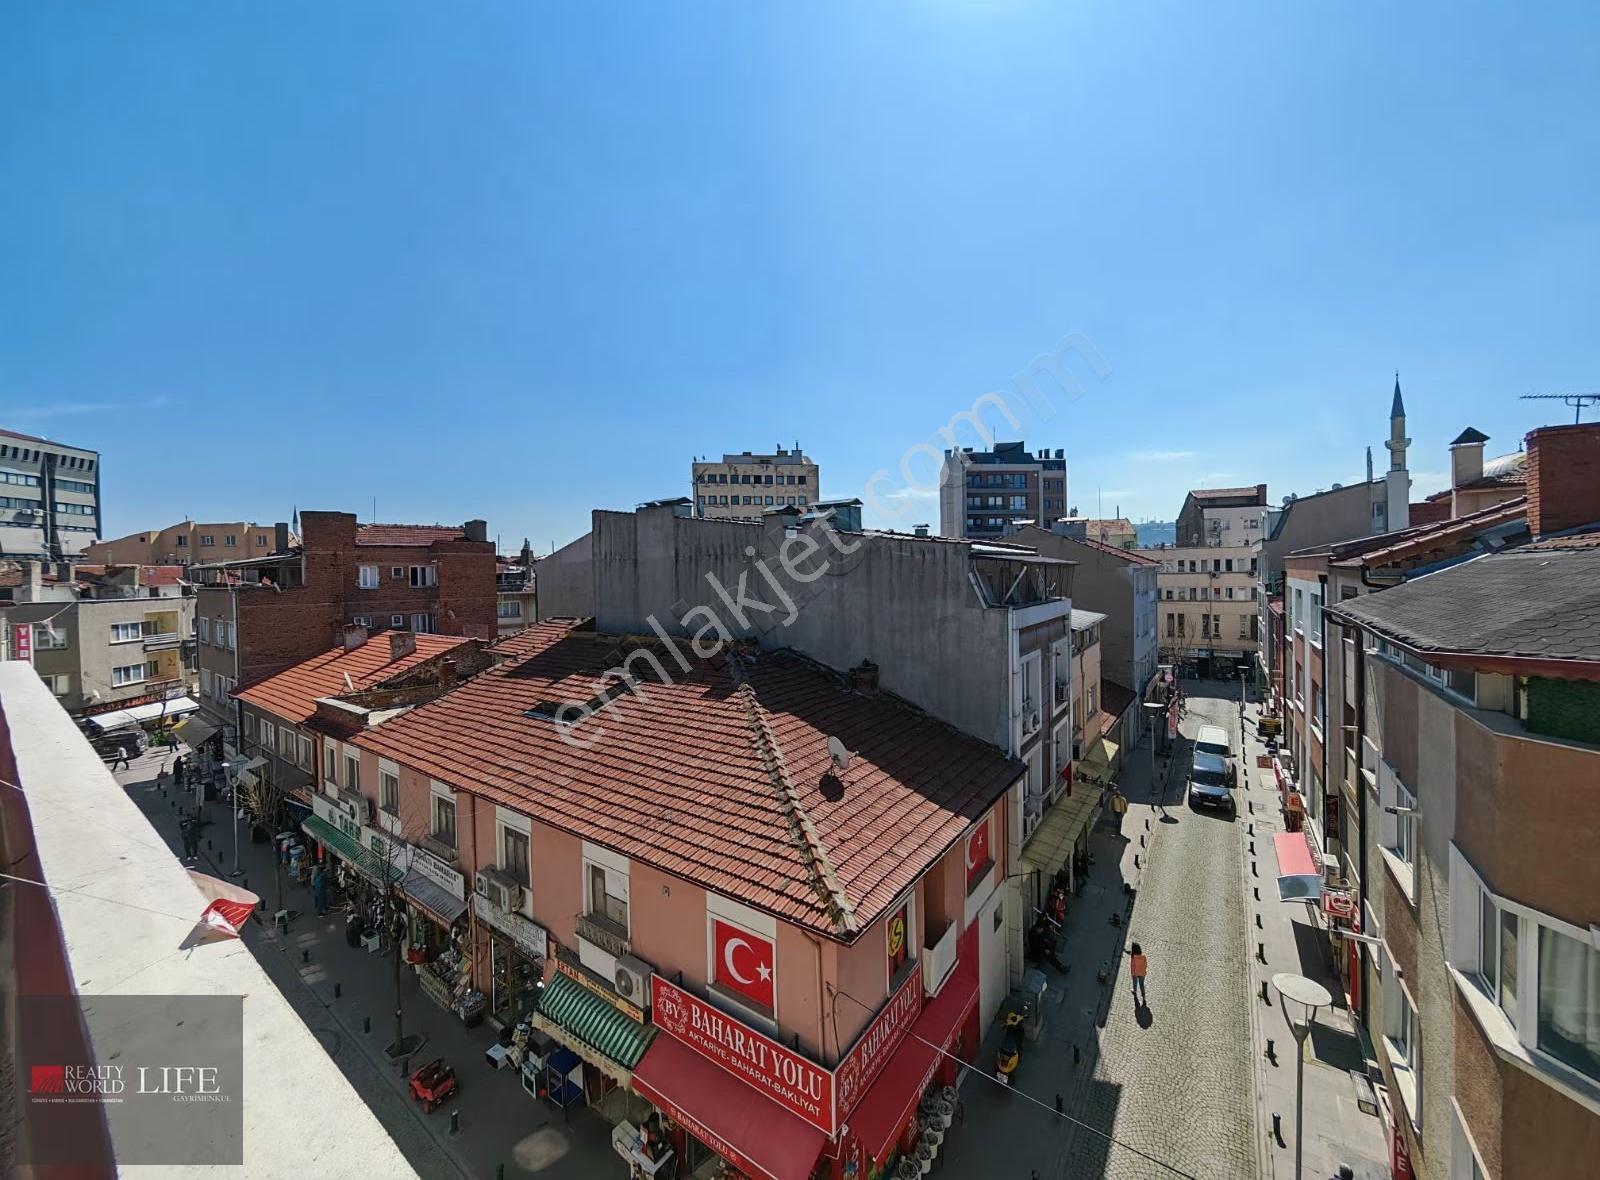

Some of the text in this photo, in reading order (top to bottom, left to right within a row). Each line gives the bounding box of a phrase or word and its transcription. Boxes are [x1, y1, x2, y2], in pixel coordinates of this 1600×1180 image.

[665, 999, 681, 1019] BY
[690, 1004, 768, 1069] BAHARAT
[771, 1050, 824, 1101] YOLU
[861, 1000, 900, 1072] BAHARAT
